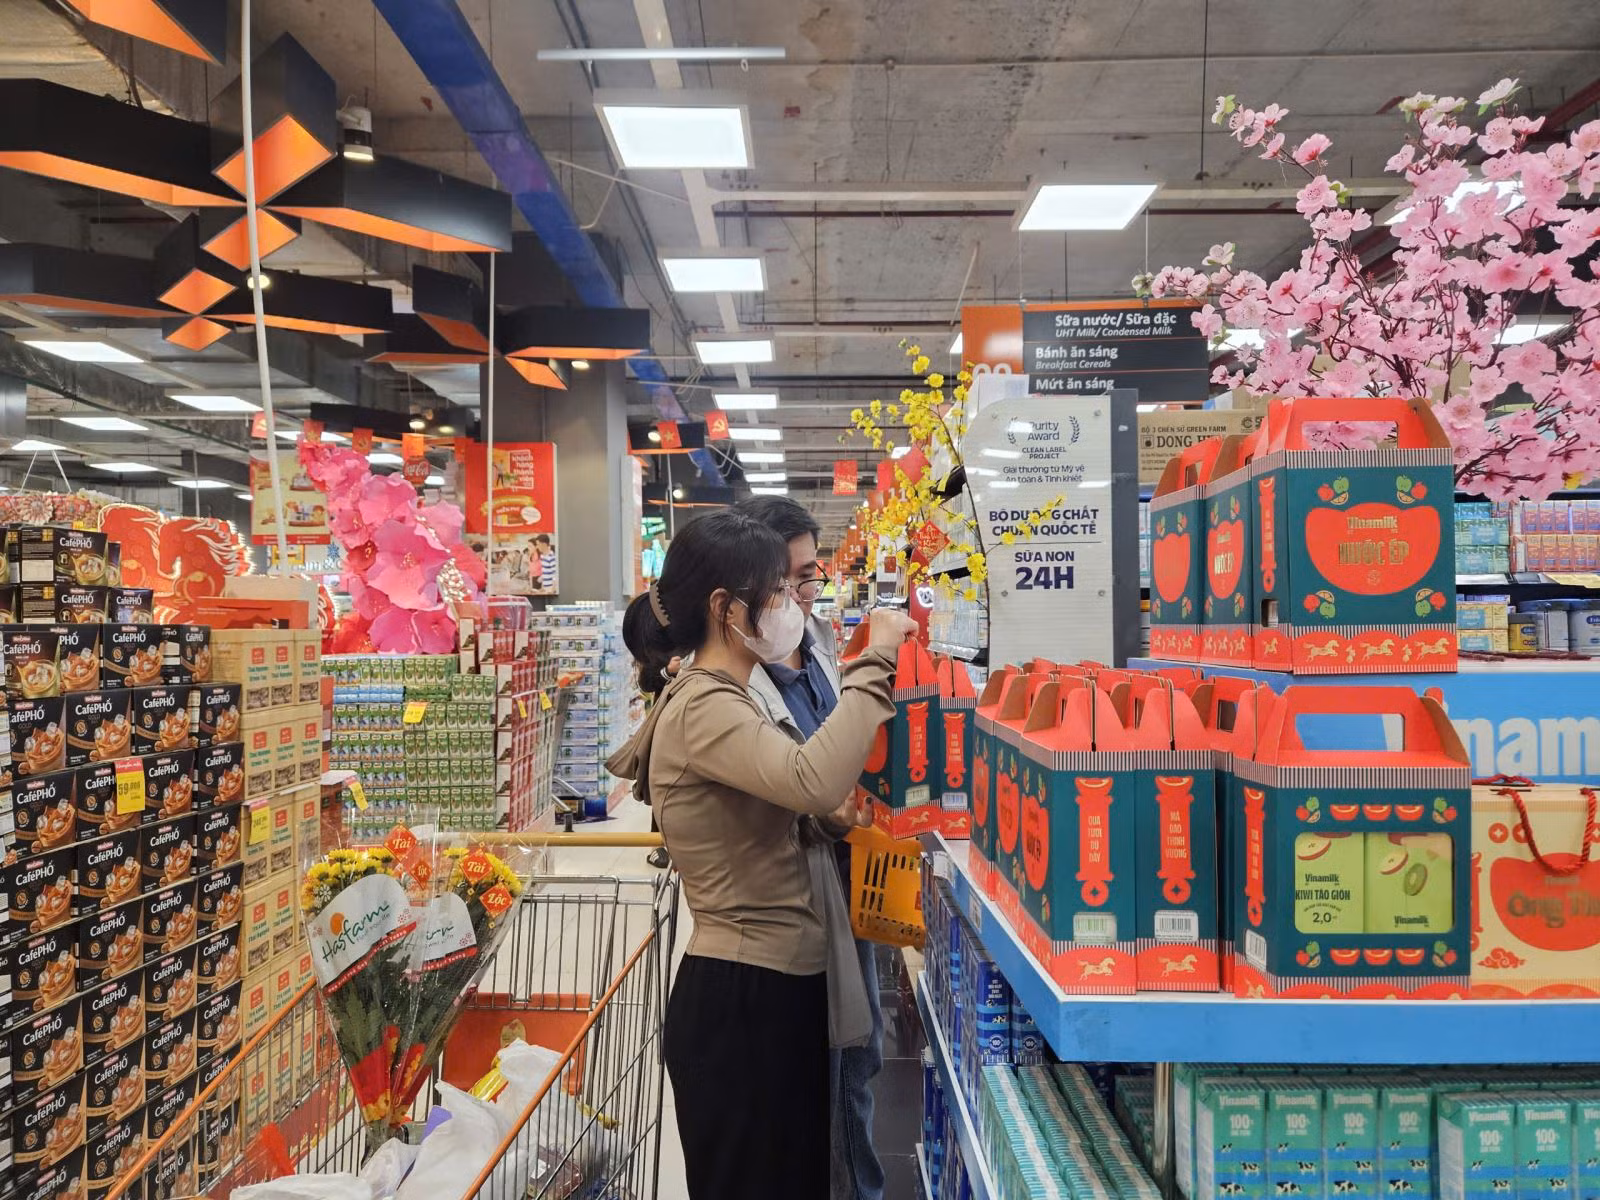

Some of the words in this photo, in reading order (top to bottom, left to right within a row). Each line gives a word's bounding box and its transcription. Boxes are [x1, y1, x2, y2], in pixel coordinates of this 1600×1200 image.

[1055, 313, 1079, 327] Sữa
[1083, 312, 1122, 327] nước/
[1126, 311, 1150, 325] Sữa
[1154, 311, 1177, 327] đặc
[1055, 329, 1075, 338] UHT
[1077, 327, 1101, 338] Milk/
[1102, 326, 1151, 337] Condensed
[1152, 326, 1173, 335] Milk
[1036, 346, 1067, 359] Bánh
[1070, 346, 1086, 358] ăn
[1089, 345, 1118, 359] sáng
[1036, 360, 1077, 371] Breakfast
[1079, 359, 1111, 369] Cereals
[1036, 377, 1064, 390] Mứt
[1067, 377, 1083, 389] ăn
[1085, 376, 1114, 392] sáng
[1028, 431, 1060, 441] Award
[1037, 475, 1043, 483] &
[989, 508, 1009, 522] BỘ
[1063, 505, 1099, 520] CHẤT
[1040, 520, 1078, 537] QUỐC
[1080, 520, 1097, 535] TẾ
[1015, 549, 1043, 563] SỮA
[1045, 550, 1075, 562] NON
[1016, 566, 1074, 590] 24H
[10, 705, 46, 723] aféPHỐ
[85, 775, 117, 790] CaféPH
[392, 836, 412, 850] Tài
[467, 860, 487, 873] Tài
[1305, 873, 1340, 883] Vinamilk
[1296, 889, 1313, 901] KIWI
[1394, 916, 1429, 925] Vinamilk
[155, 1151, 184, 1184] CaféPỐ
